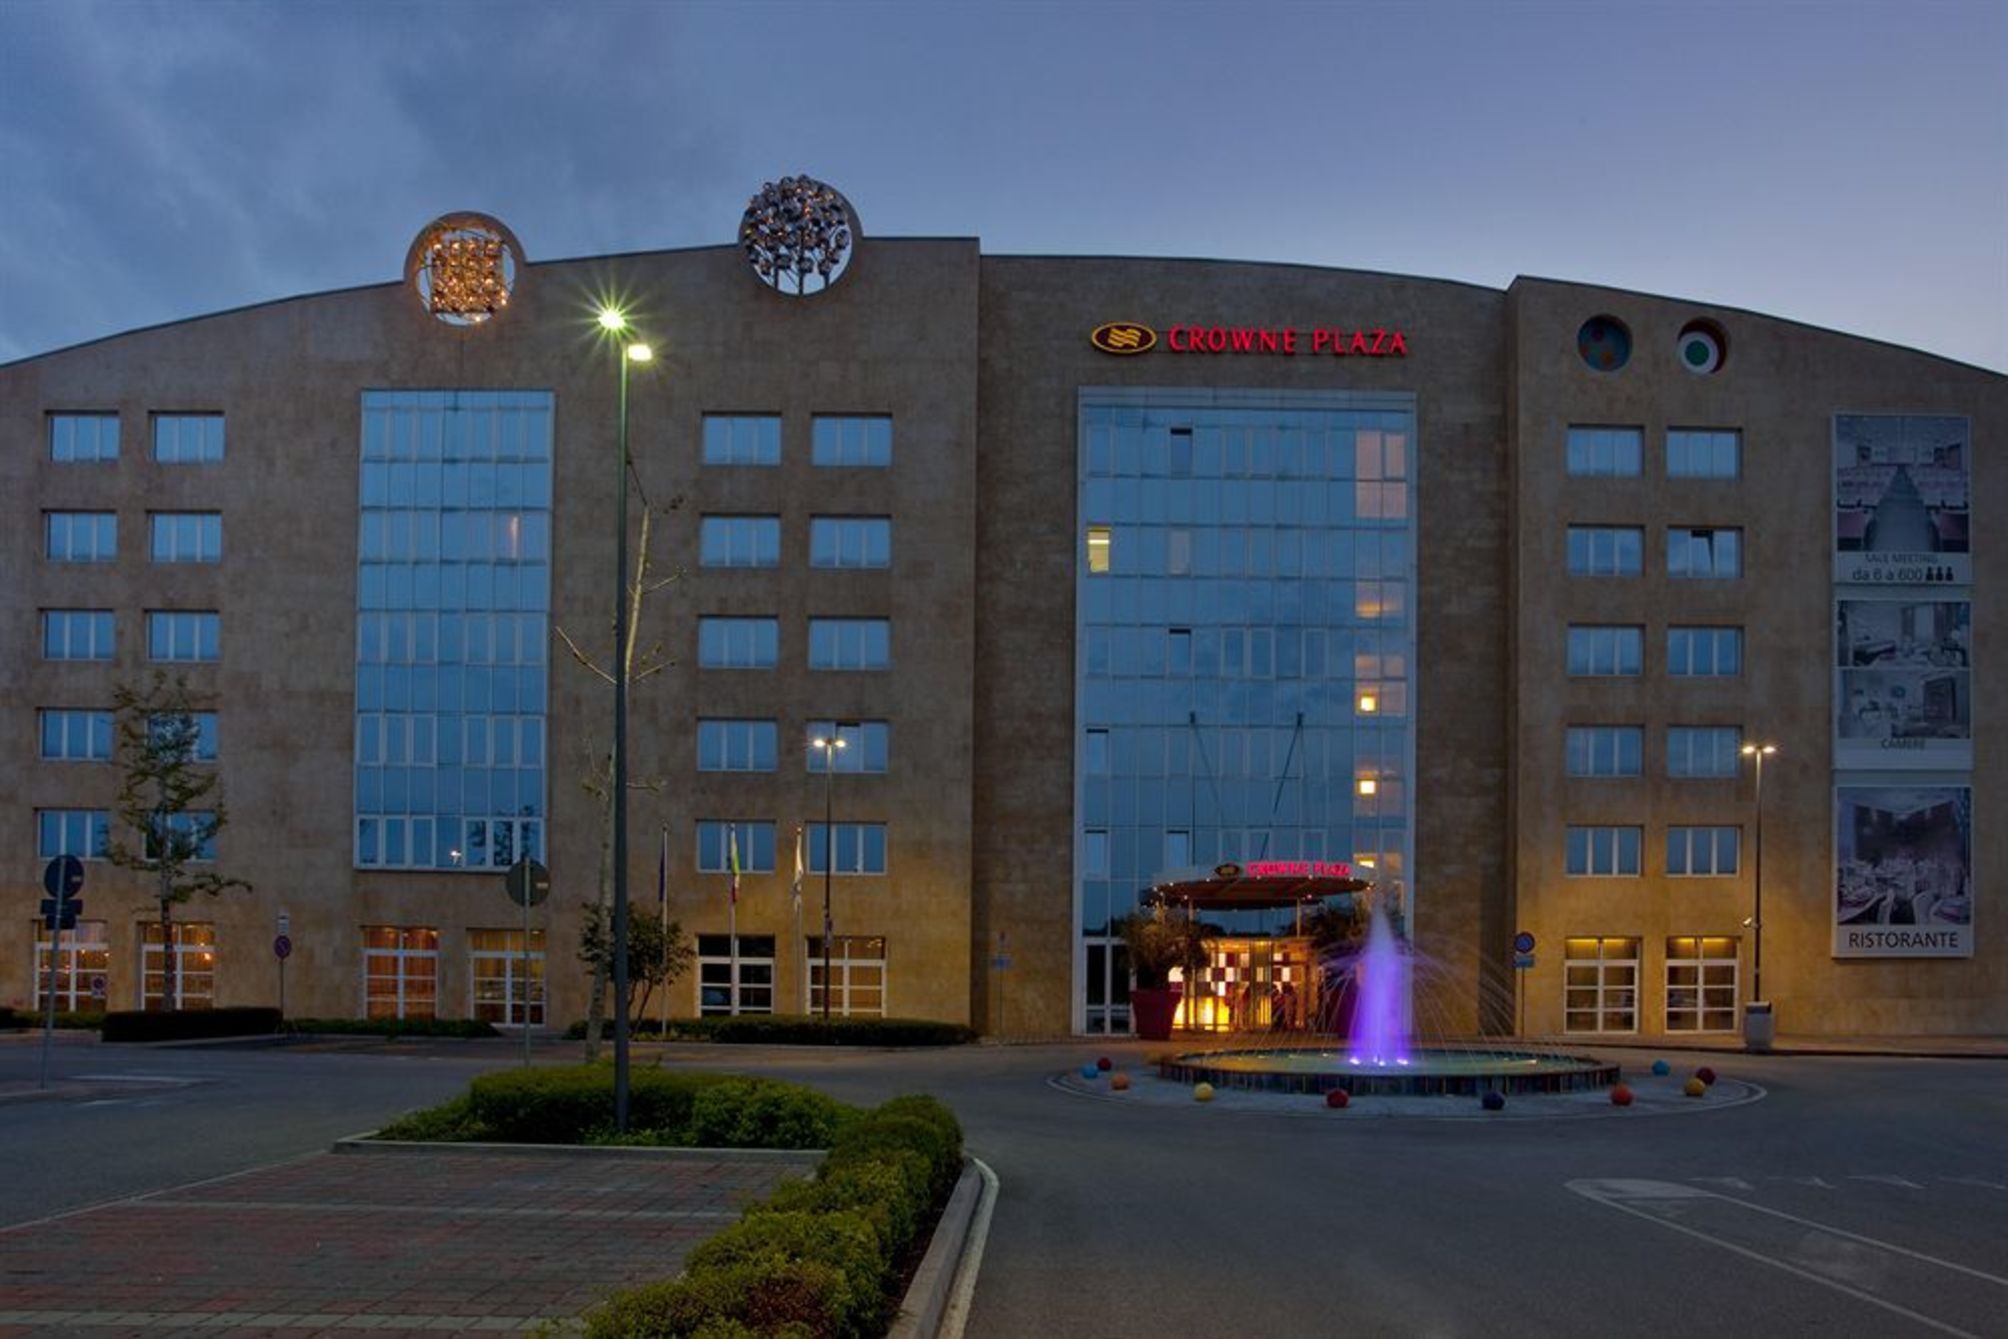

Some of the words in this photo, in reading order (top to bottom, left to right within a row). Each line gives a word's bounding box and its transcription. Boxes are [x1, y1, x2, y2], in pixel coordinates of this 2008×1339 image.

[1168, 325, 1297, 354] CROWNE
[1312, 327, 1408, 355] PLAZA
[1853, 566, 1870, 581] da
[1247, 861, 1309, 876] CROWNE
[1313, 861, 1351, 876] PLAZA
[1848, 932, 1959, 949] RISTORANTE
